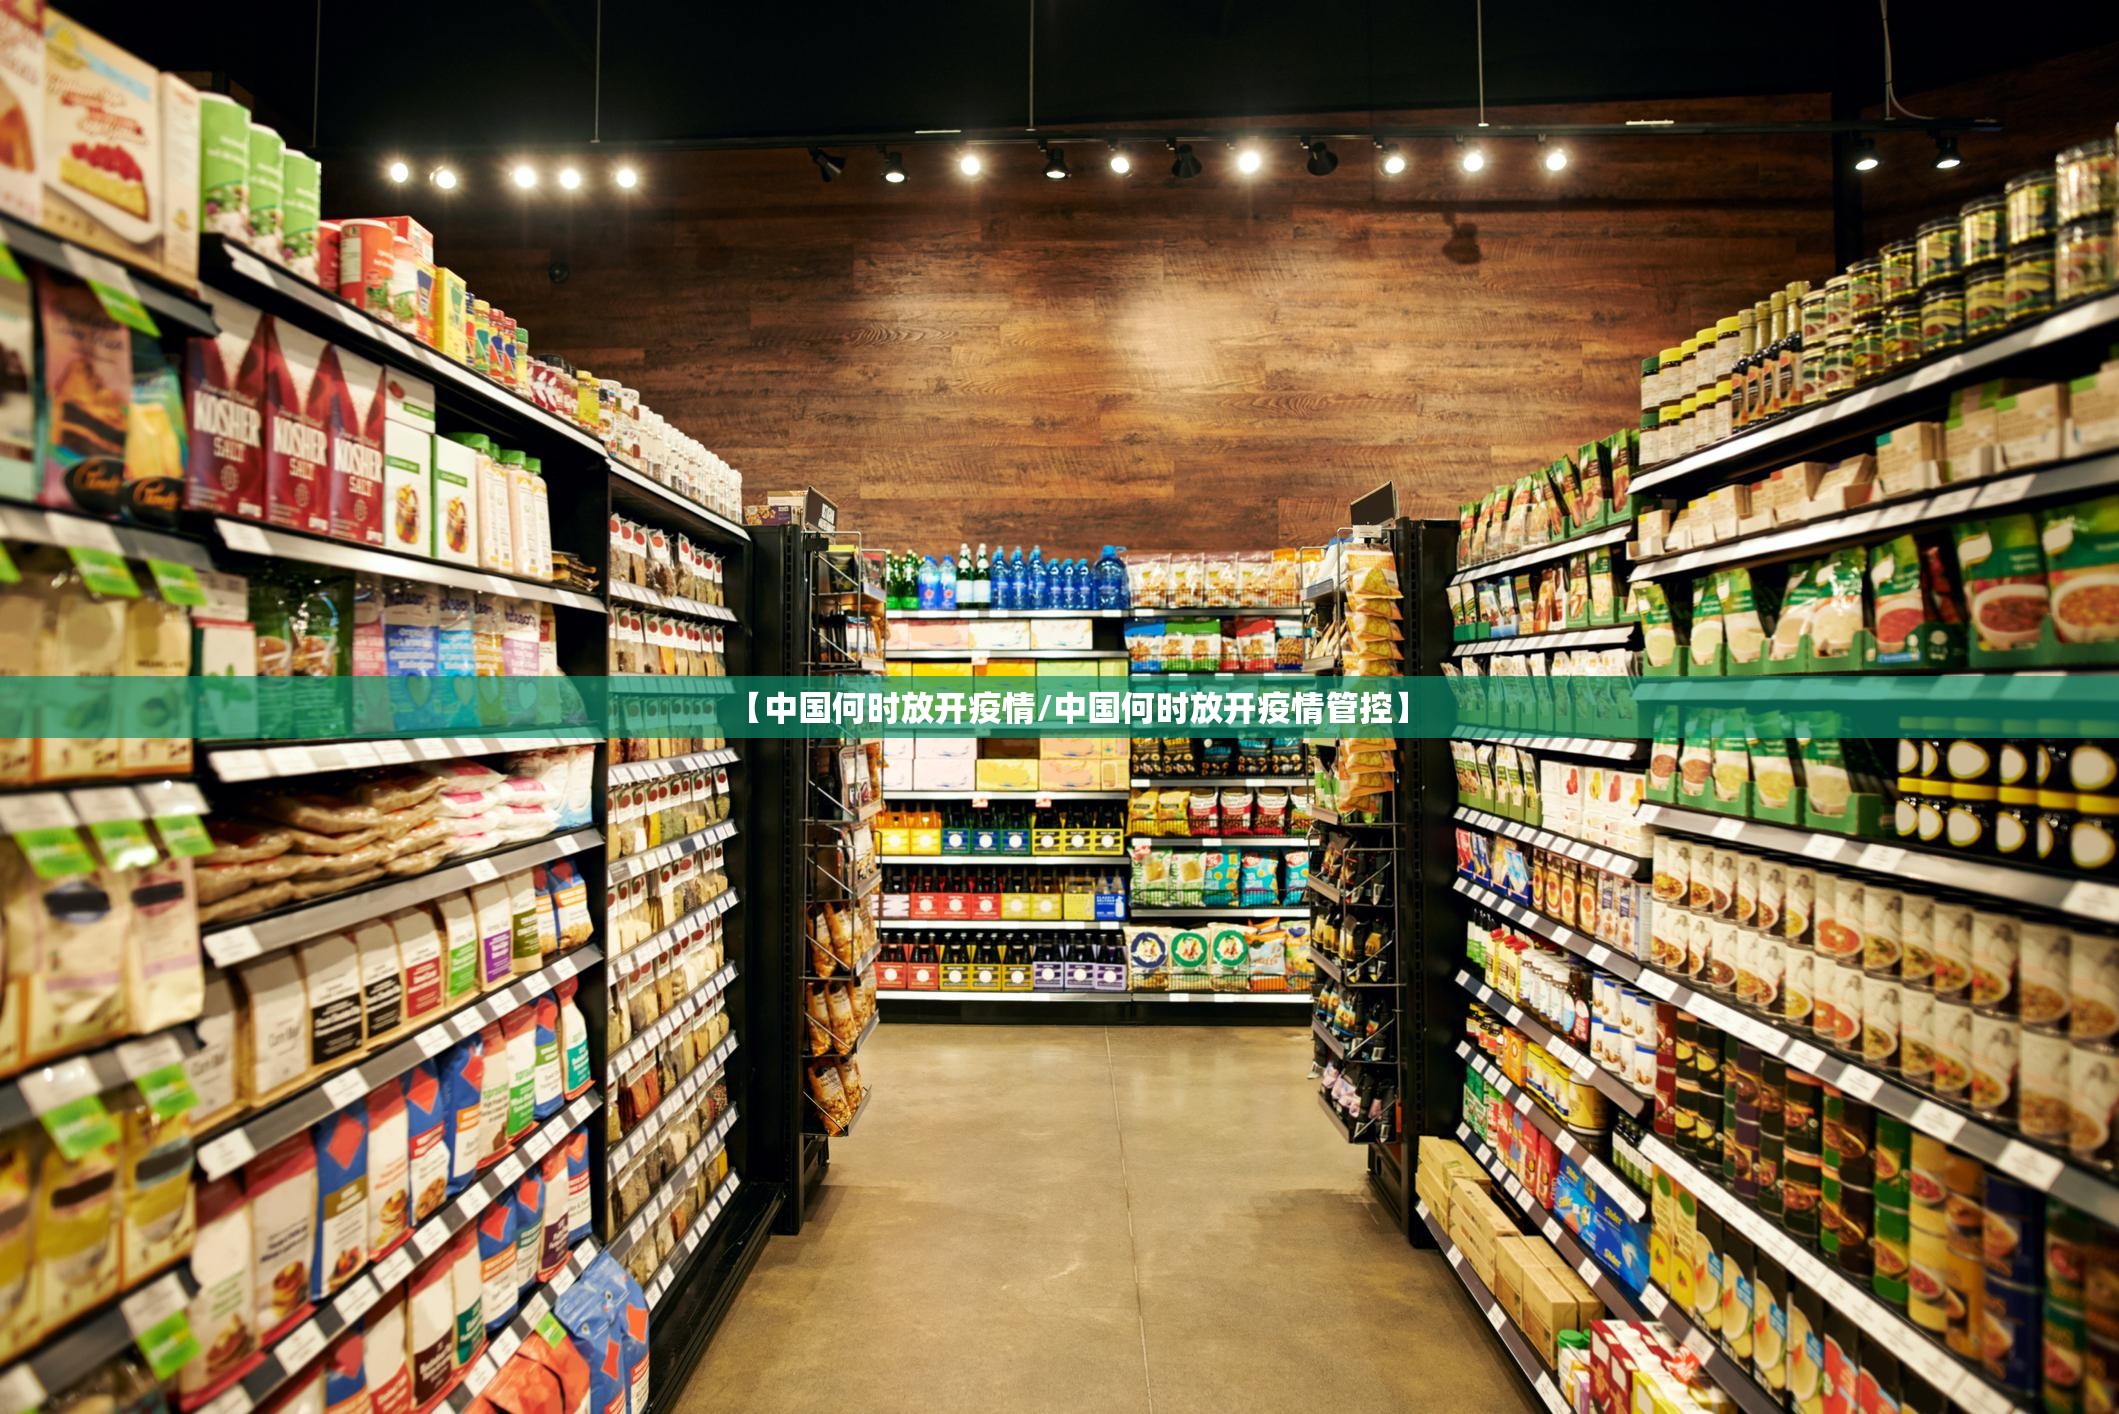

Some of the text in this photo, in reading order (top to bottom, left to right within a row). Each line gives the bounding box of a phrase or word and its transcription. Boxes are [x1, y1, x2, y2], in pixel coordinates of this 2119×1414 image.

[194, 390, 262, 448] KOSHER
[213, 437, 246, 463] SALT
[273, 415, 327, 467] KOSHER
[289, 458, 316, 481] SALT
[333, 437, 383, 483] KOSHER
[348, 476, 374, 497] SALT
